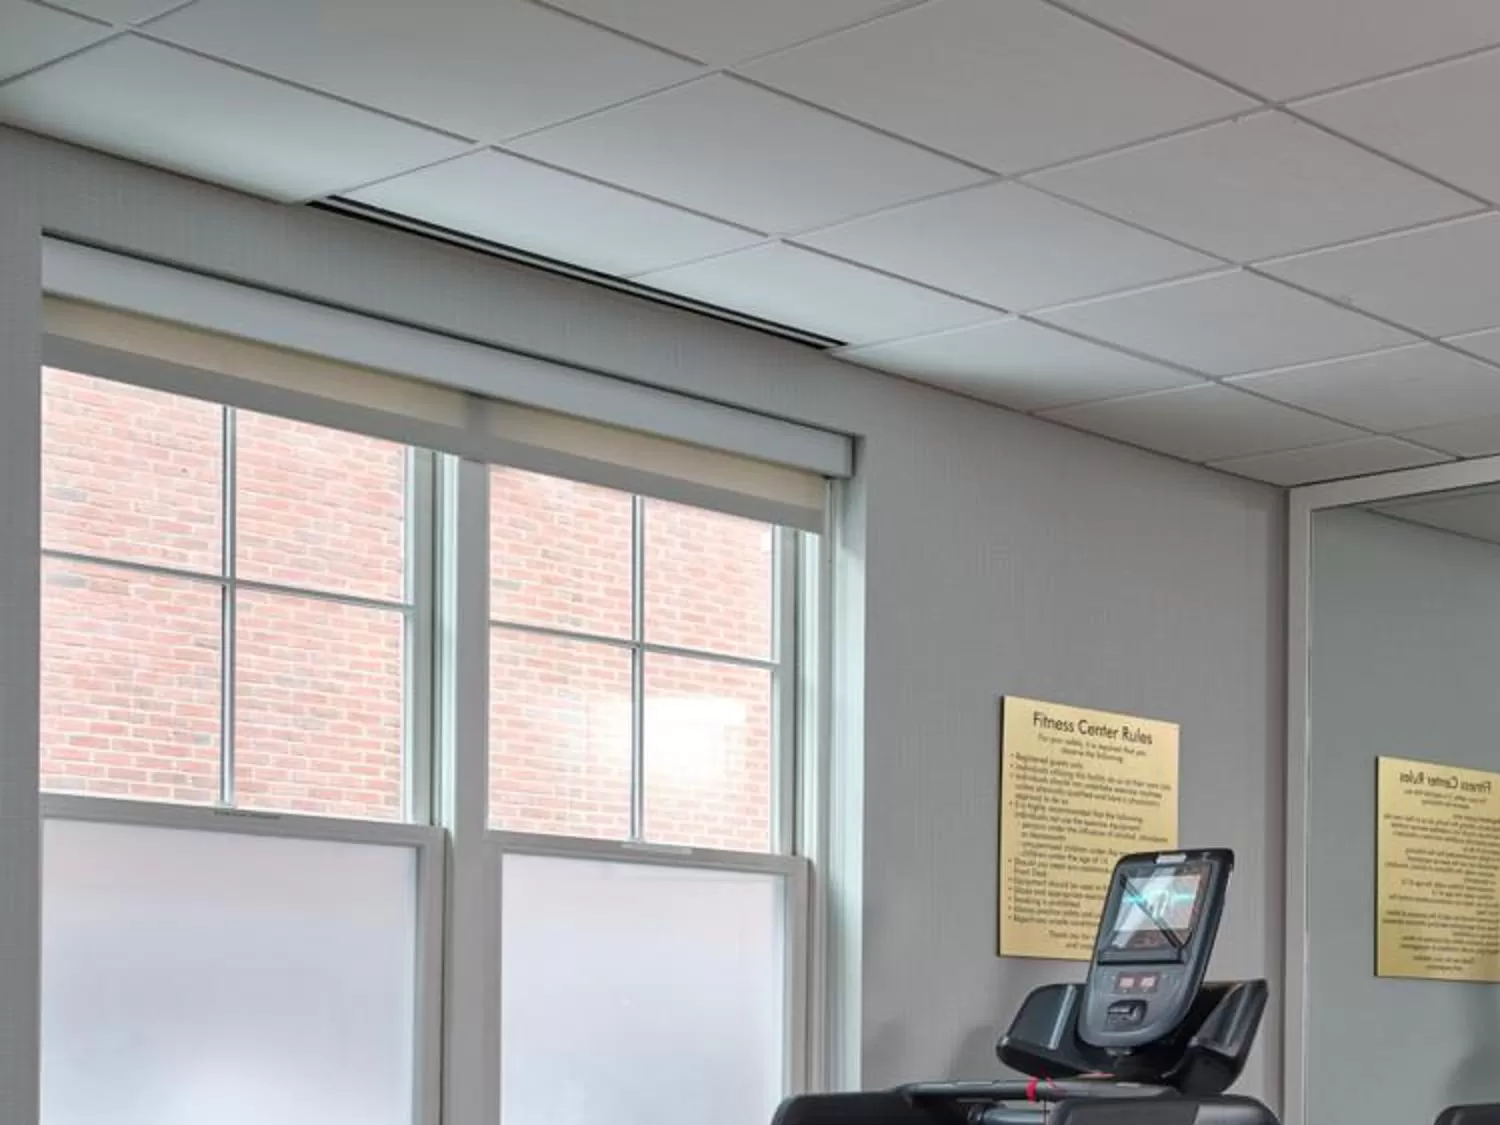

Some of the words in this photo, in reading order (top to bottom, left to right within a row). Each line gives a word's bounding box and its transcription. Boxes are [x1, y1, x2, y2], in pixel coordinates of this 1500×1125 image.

[1033, 711, 1075, 732] Fitness
[1078, 719, 1119, 739] Center
[1121, 726, 1153, 744] Rules
